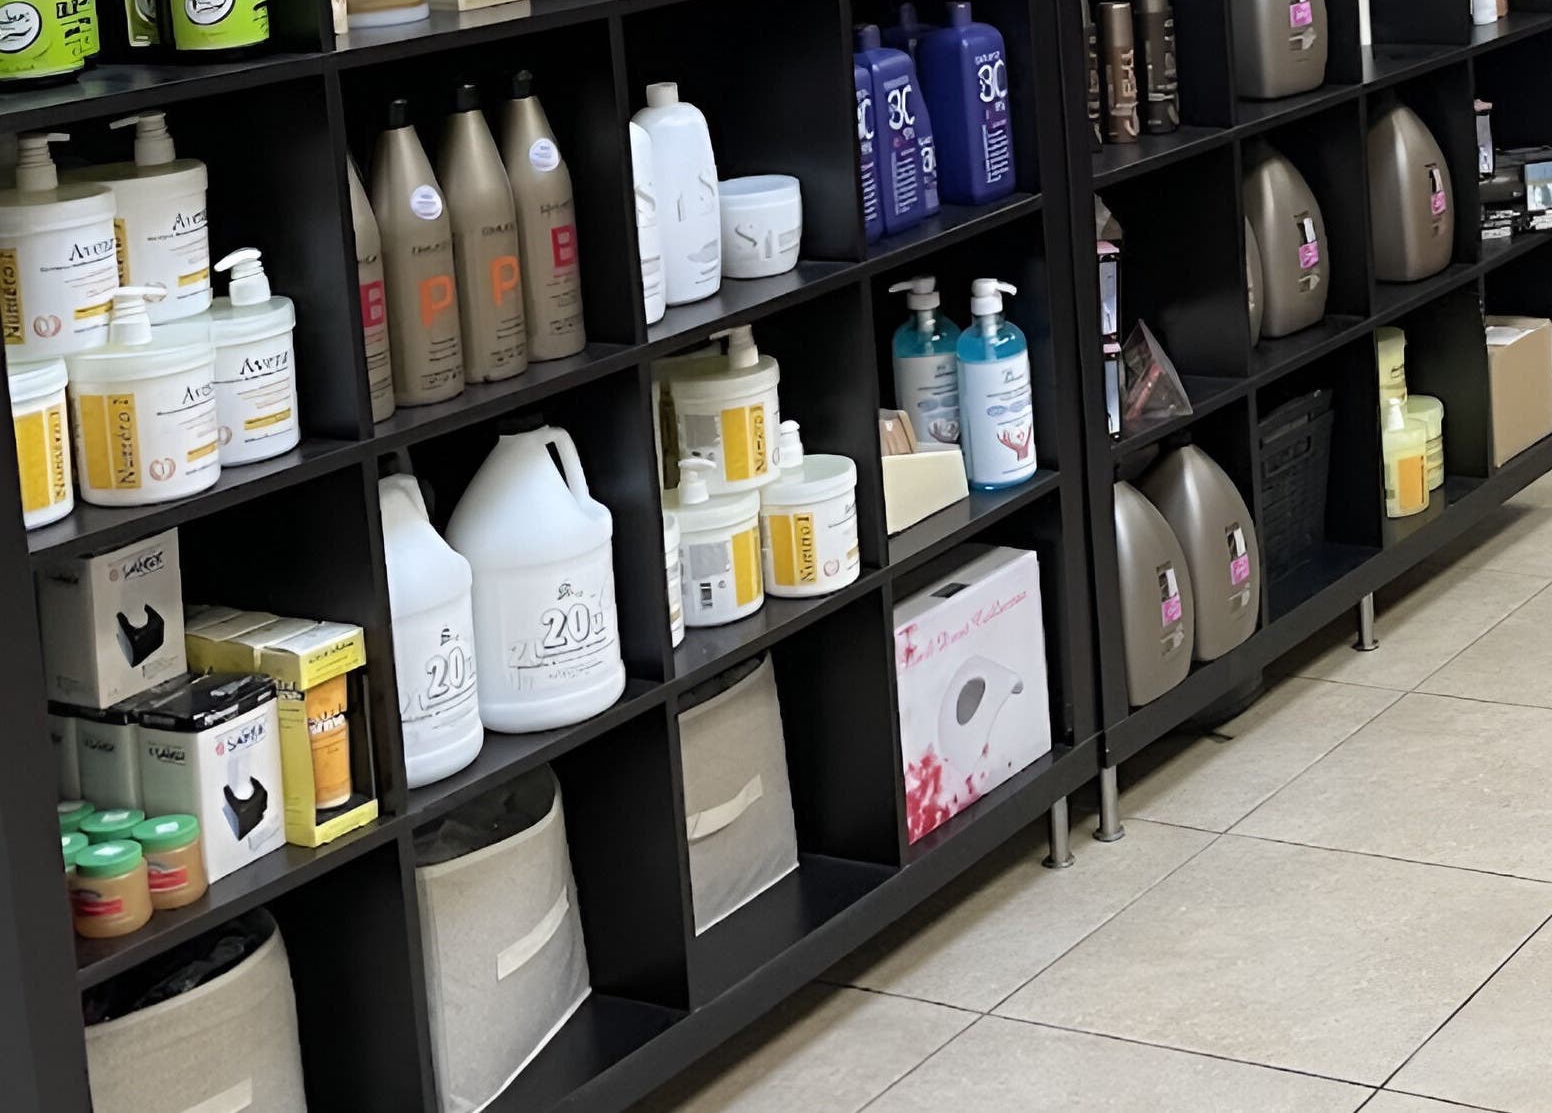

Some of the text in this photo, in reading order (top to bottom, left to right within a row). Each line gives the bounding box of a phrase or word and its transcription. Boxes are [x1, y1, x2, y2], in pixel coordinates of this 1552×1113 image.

[418, 274, 454, 329] P
[489, 255, 520, 307] P
[540, 602, 591, 650] 20
